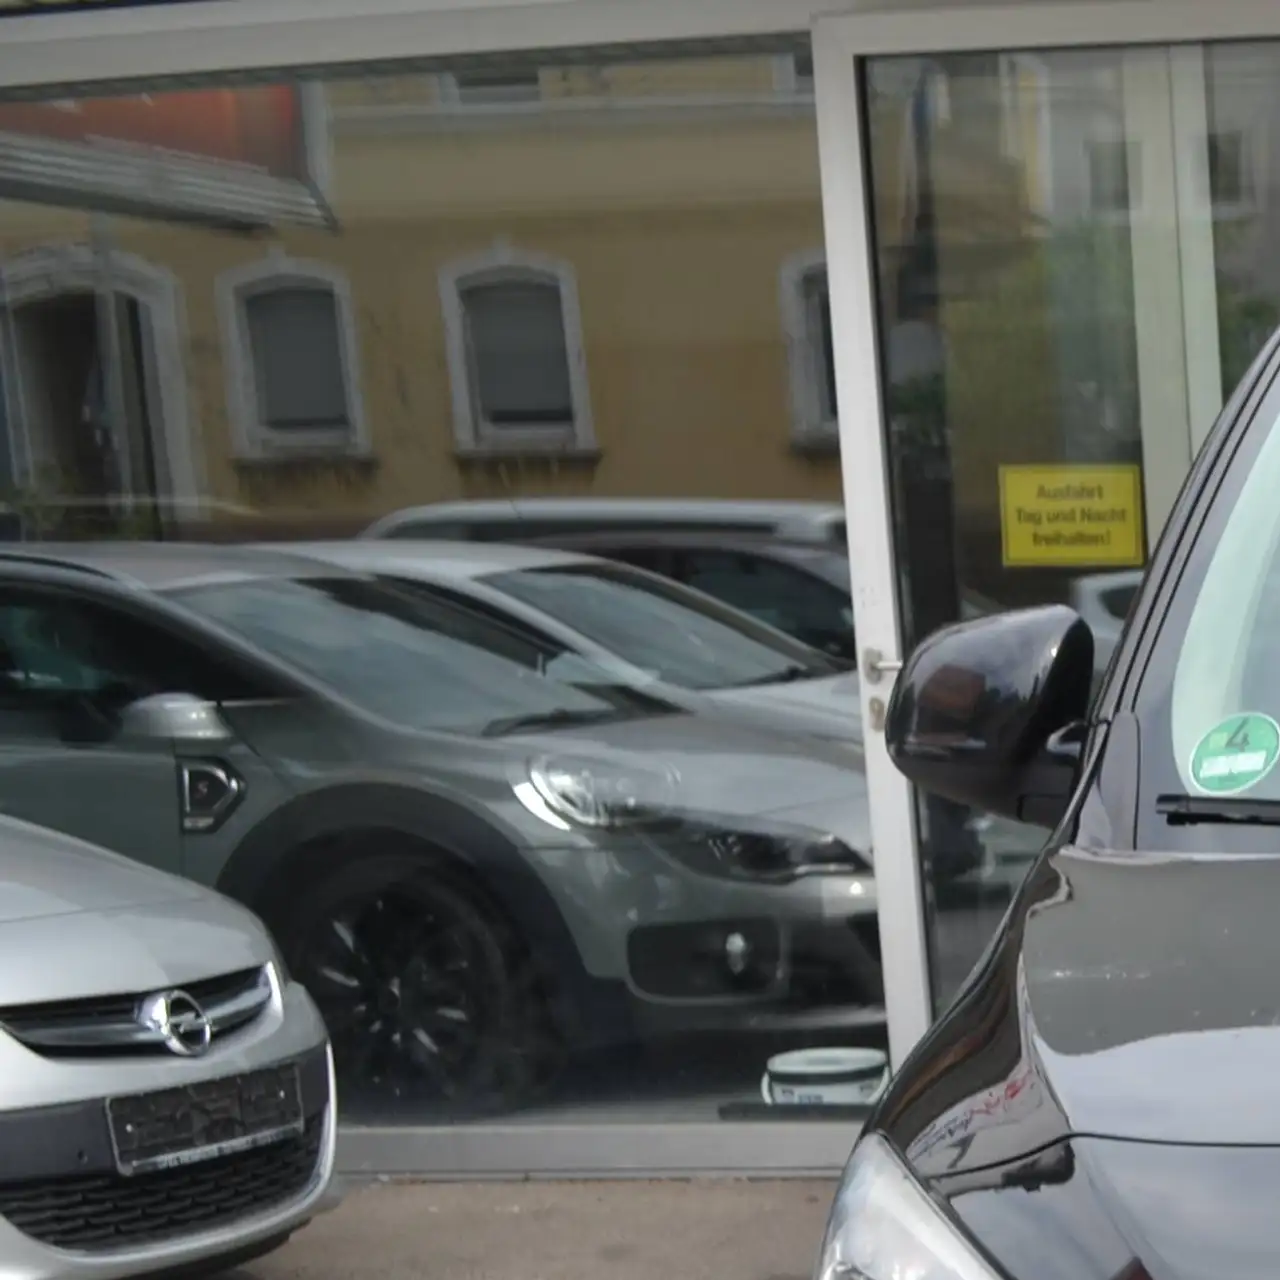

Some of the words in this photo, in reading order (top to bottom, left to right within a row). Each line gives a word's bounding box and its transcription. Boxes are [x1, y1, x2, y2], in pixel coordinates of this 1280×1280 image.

[1036, 484, 1104, 500] Ausfahrt
[1016, 507, 1042, 525] Tag
[1046, 507, 1077, 523] und
[1080, 507, 1126, 523] Nacht
[1031, 531, 1111, 547] freihalten!
